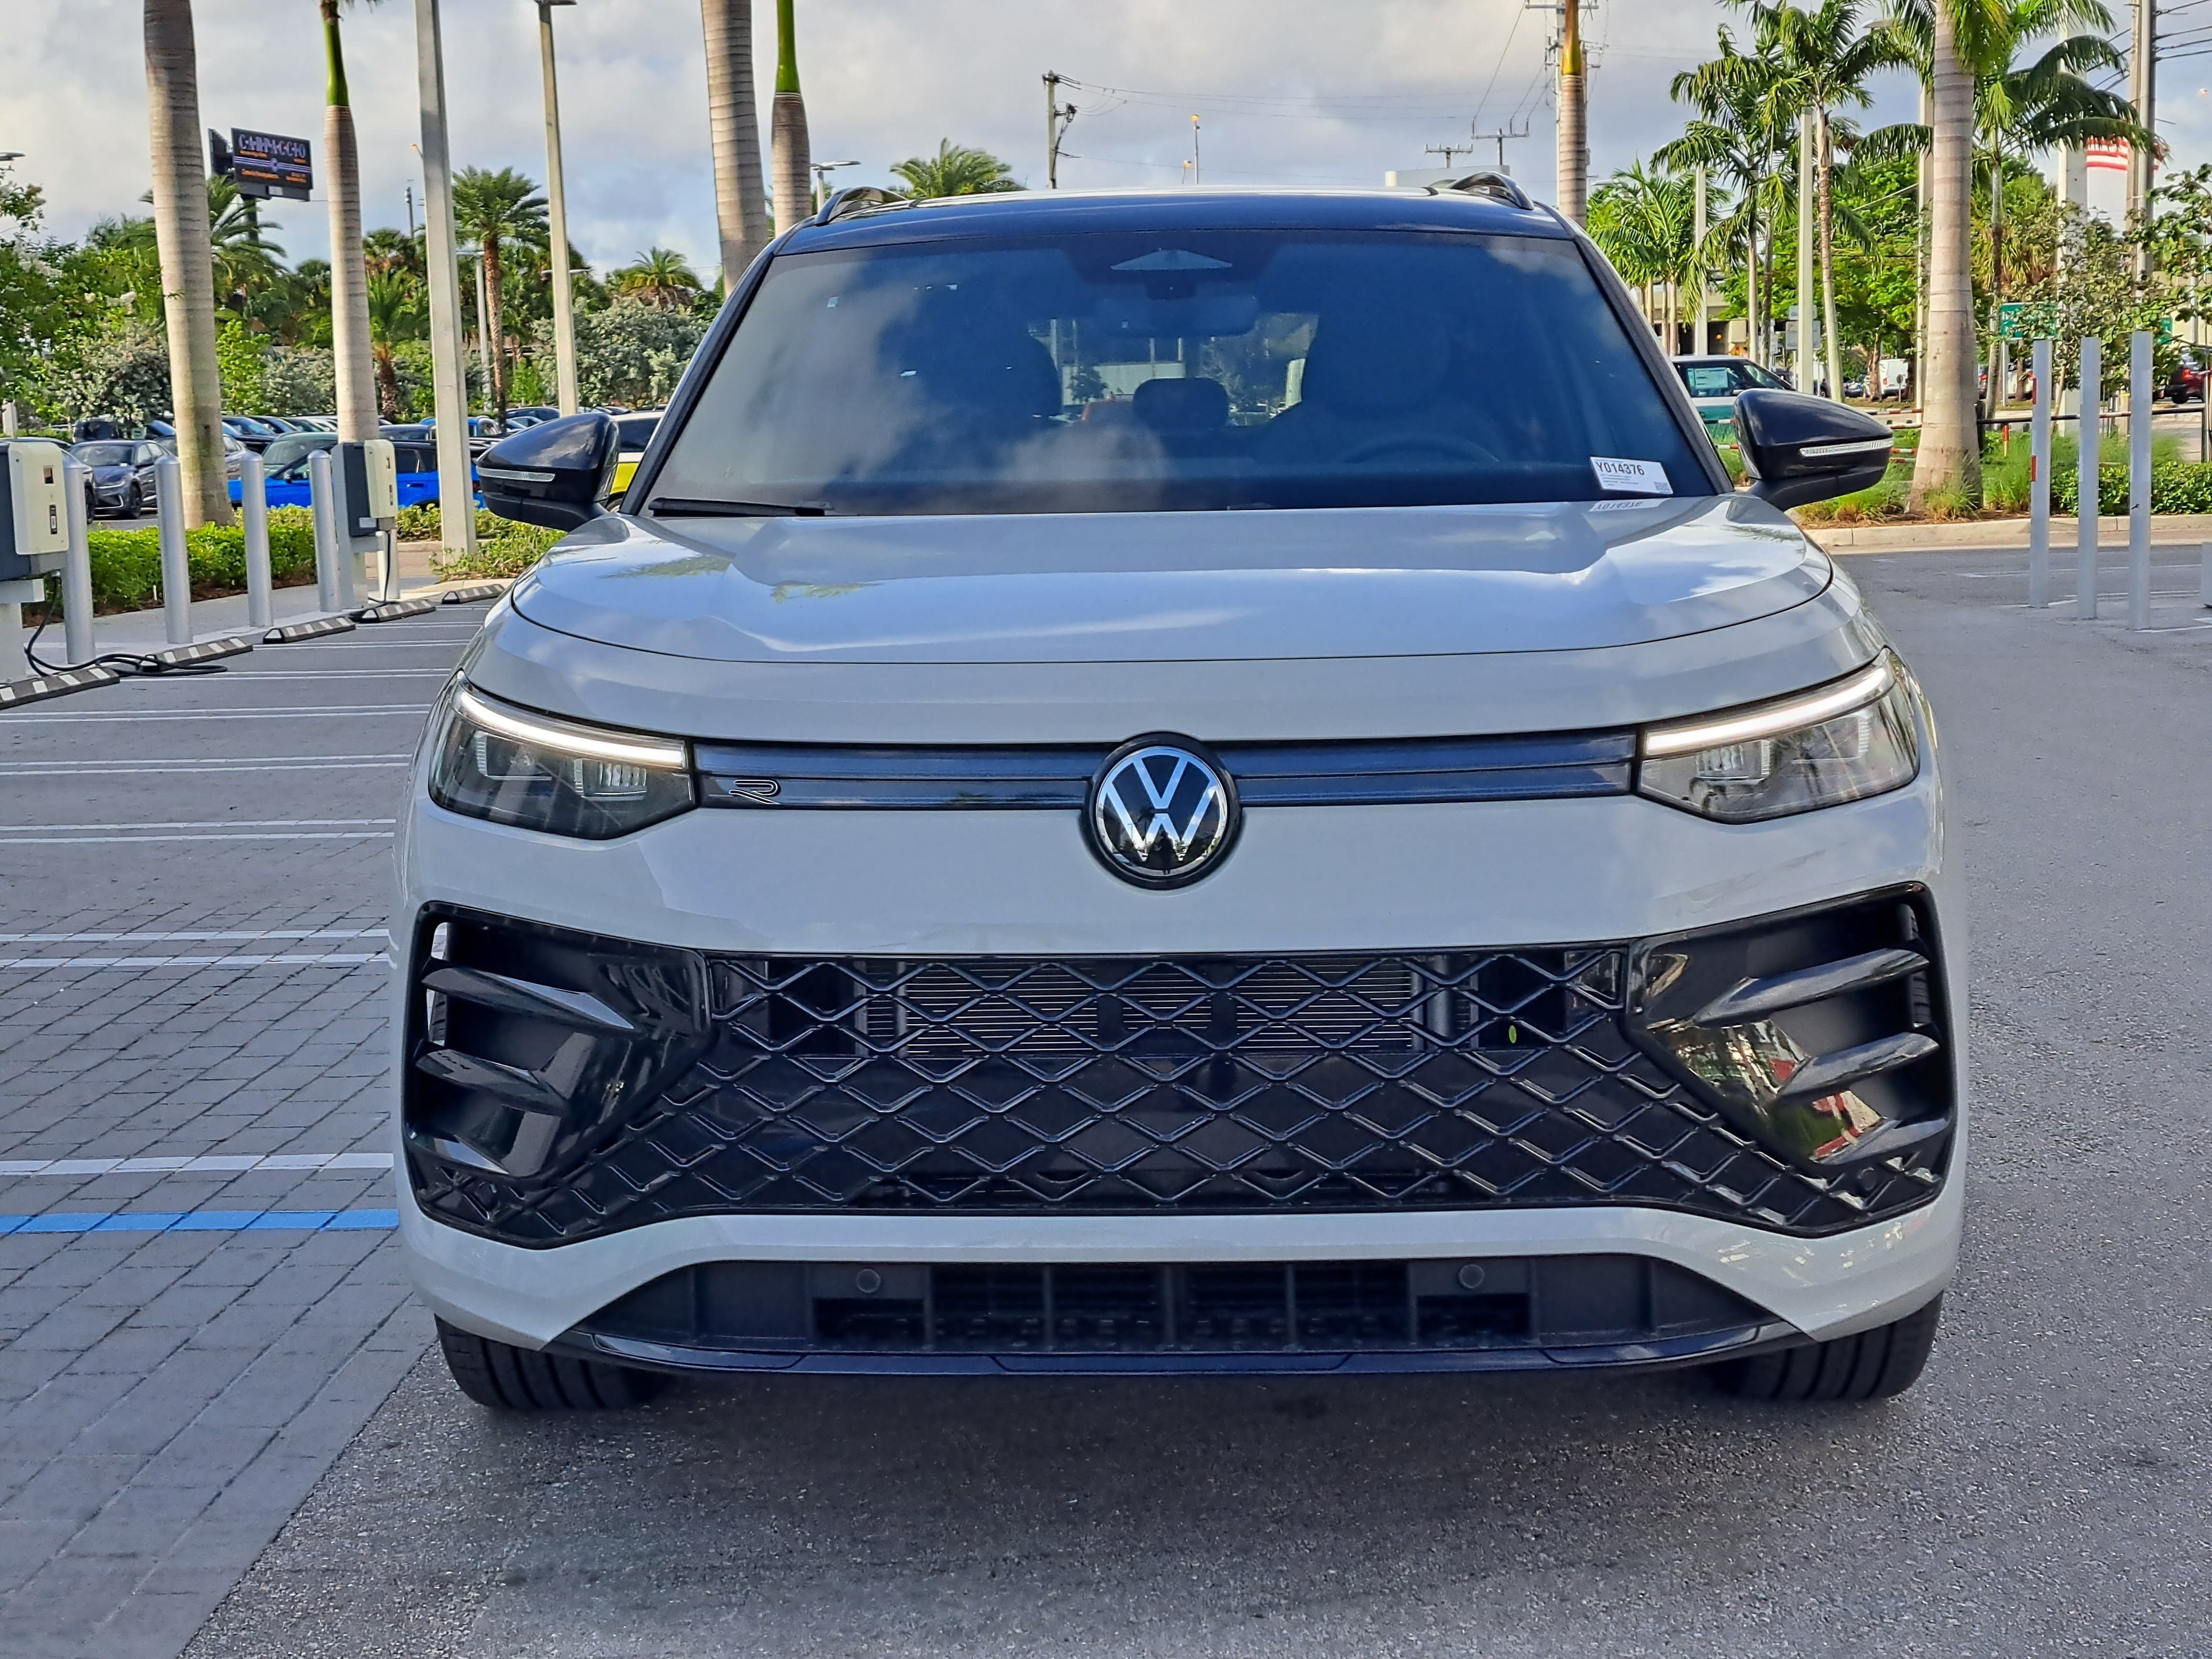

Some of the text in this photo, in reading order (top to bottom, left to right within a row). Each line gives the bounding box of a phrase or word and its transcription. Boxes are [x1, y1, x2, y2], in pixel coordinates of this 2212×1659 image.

[1595, 461, 1645, 476] Y014376
[729, 779, 782, 805] R
[1099, 749, 1225, 867] VW
